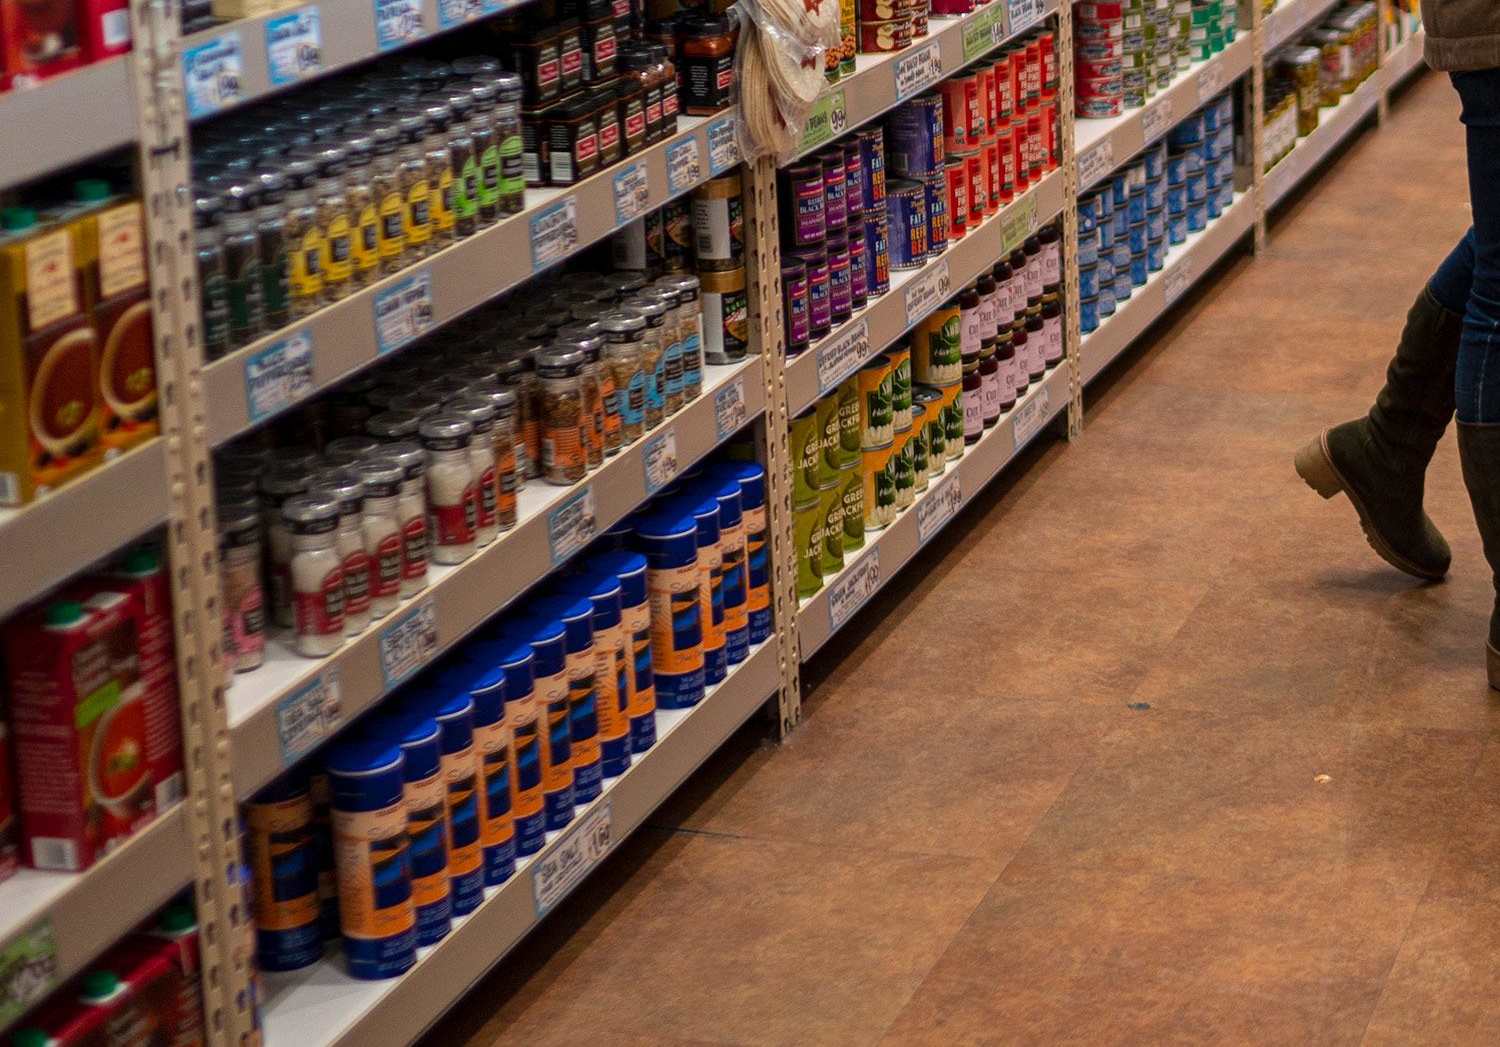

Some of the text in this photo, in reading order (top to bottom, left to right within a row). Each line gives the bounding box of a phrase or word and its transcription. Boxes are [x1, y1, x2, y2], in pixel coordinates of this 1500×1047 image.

[800, 204, 818, 214] BLACK
[932, 203, 942, 214] FAT
[910, 214, 921, 225] FAT
